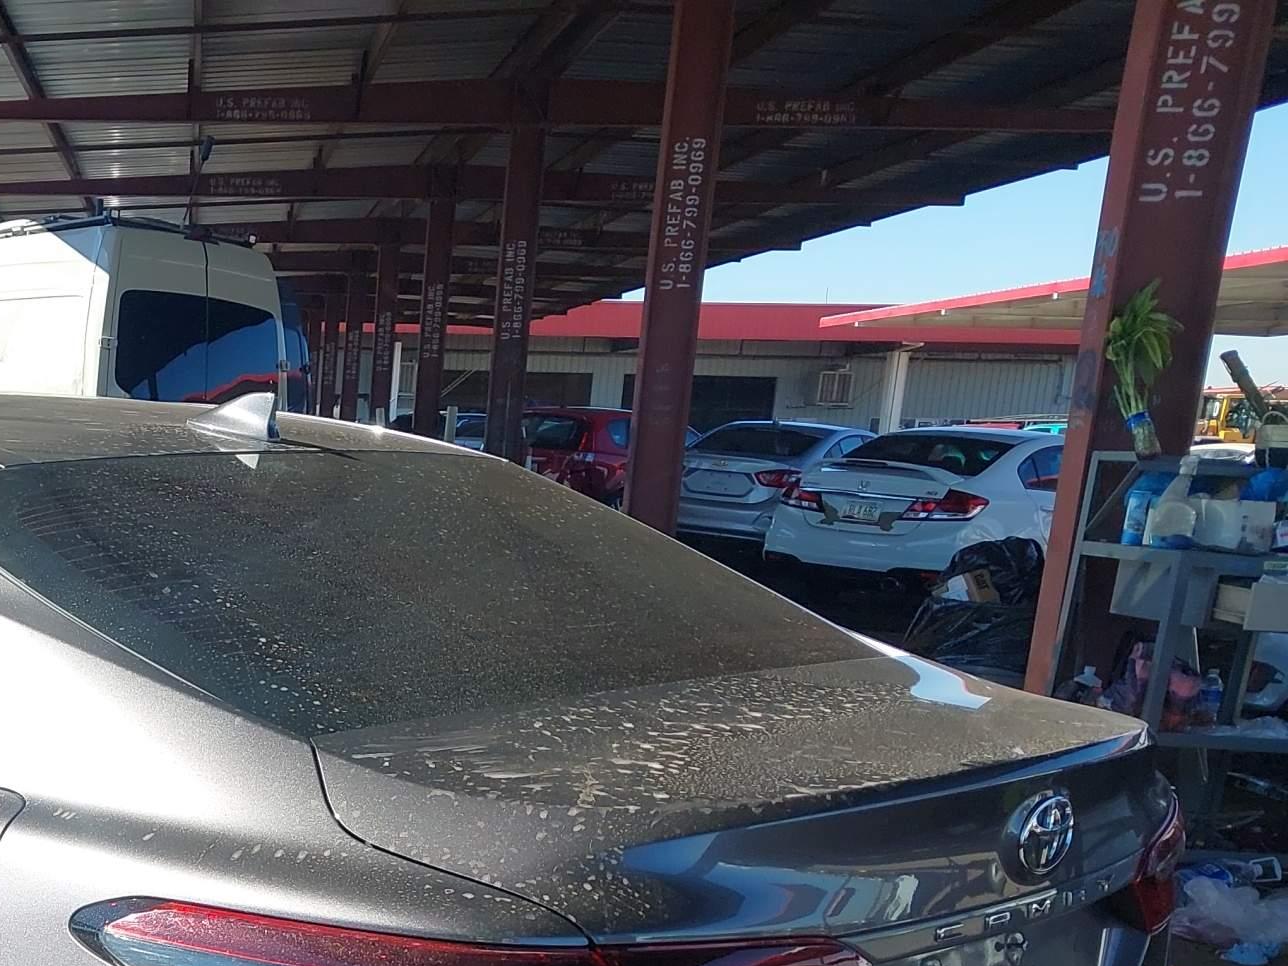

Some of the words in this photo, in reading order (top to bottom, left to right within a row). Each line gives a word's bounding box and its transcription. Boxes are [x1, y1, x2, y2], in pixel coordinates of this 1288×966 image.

[673, 136, 690, 170] INC.
[1138, 137, 1179, 203] U.S.
[664, 179, 684, 247] PREFAB
[676, 138, 706, 288] 1-866-799-0969
[502, 267, 514, 312] PREFAB
